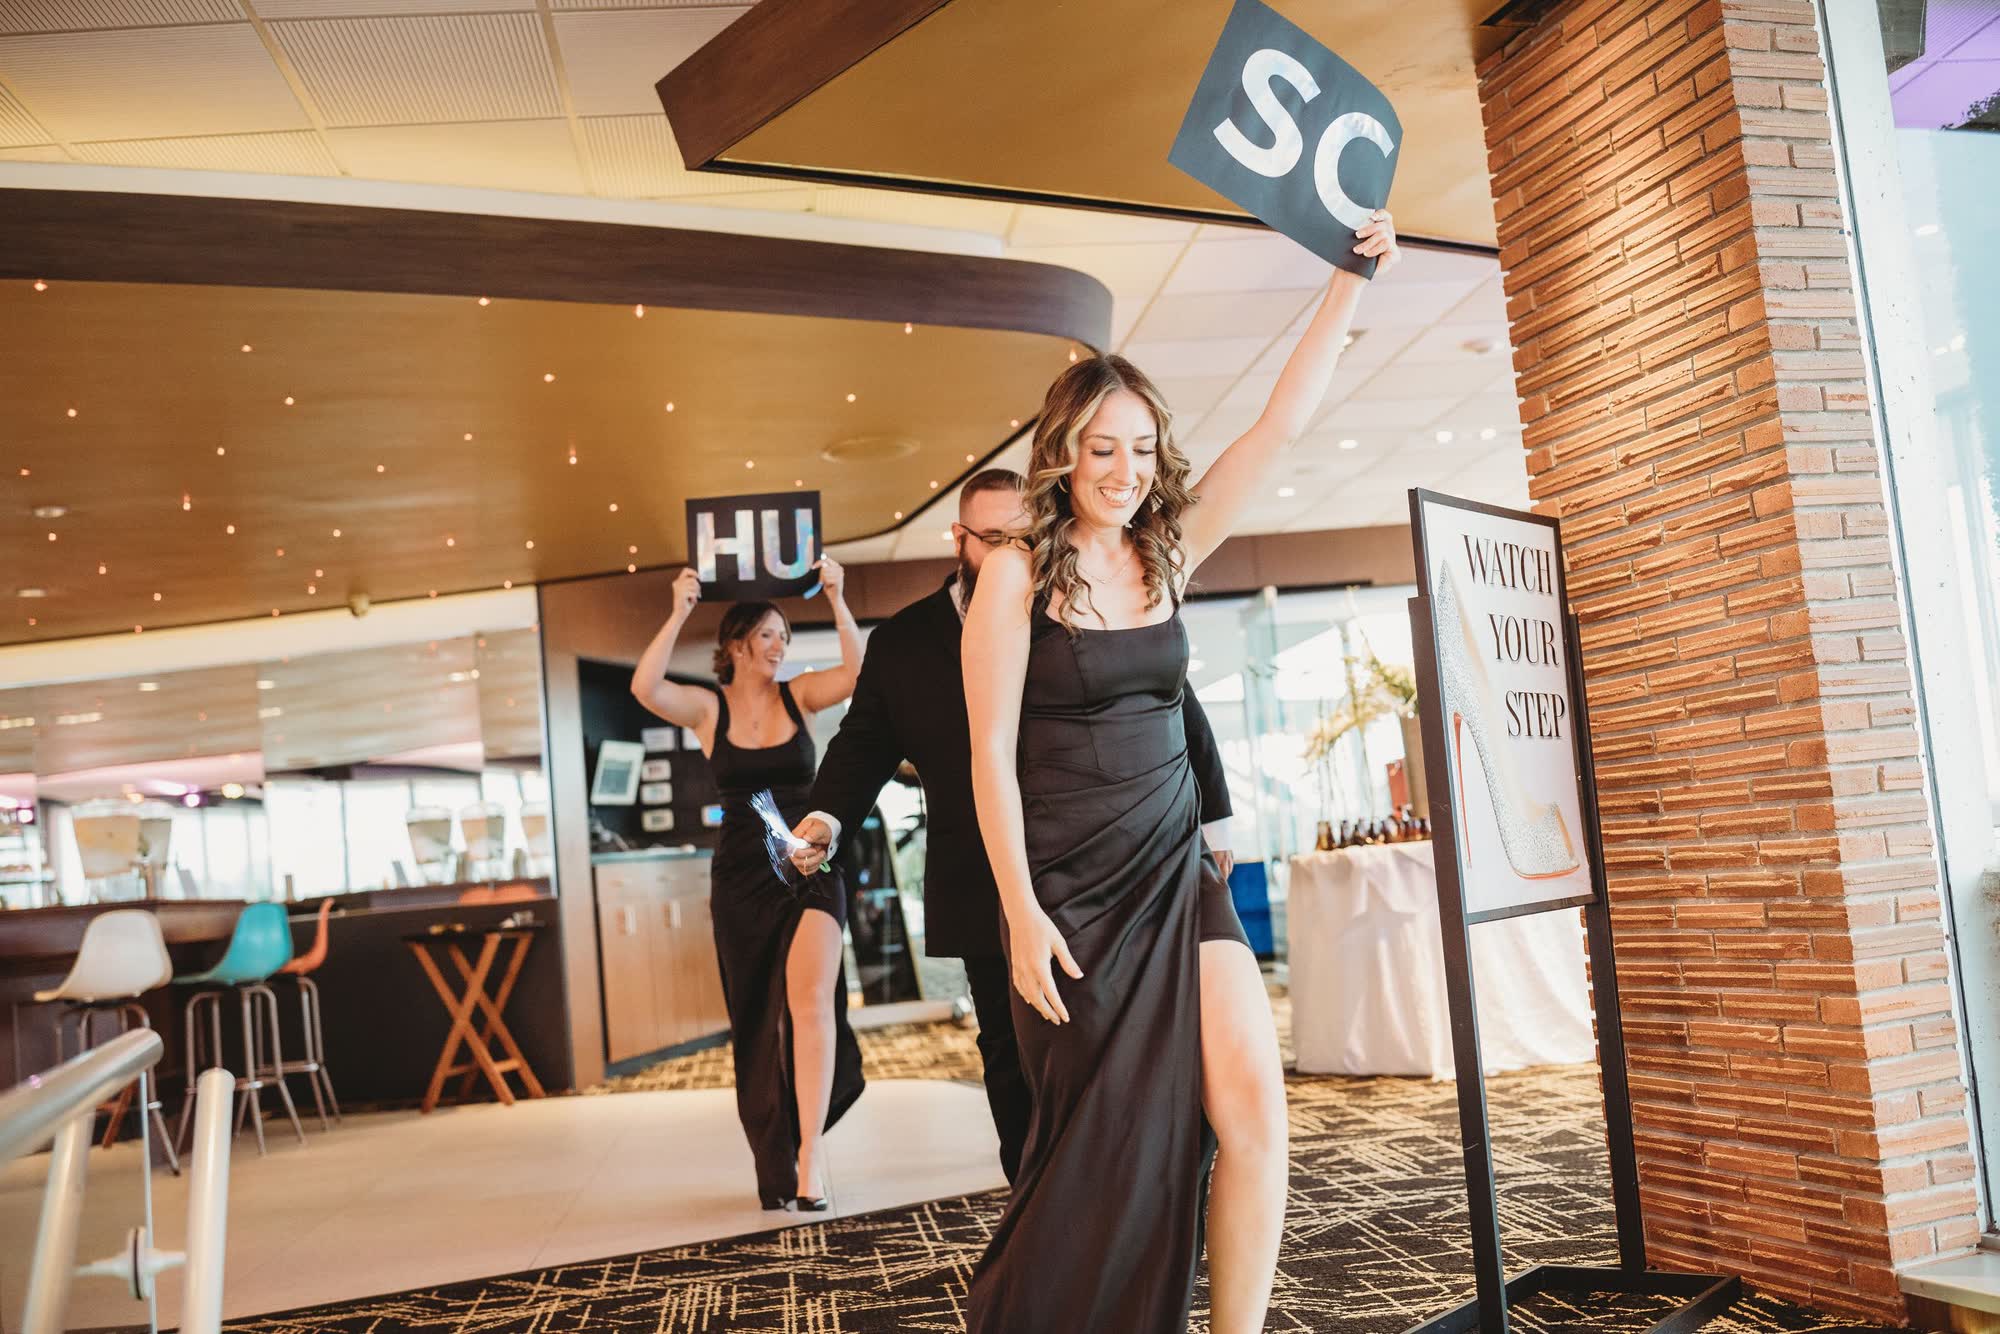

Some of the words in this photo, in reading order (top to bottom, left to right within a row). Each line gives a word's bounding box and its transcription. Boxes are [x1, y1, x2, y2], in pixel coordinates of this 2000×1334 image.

[1213, 49, 1395, 231] SC
[696, 508, 815, 582] HU
[1463, 534, 1554, 595] WATCH
[1488, 613, 1560, 666] YOUR
[1505, 689, 1565, 739] STEP
